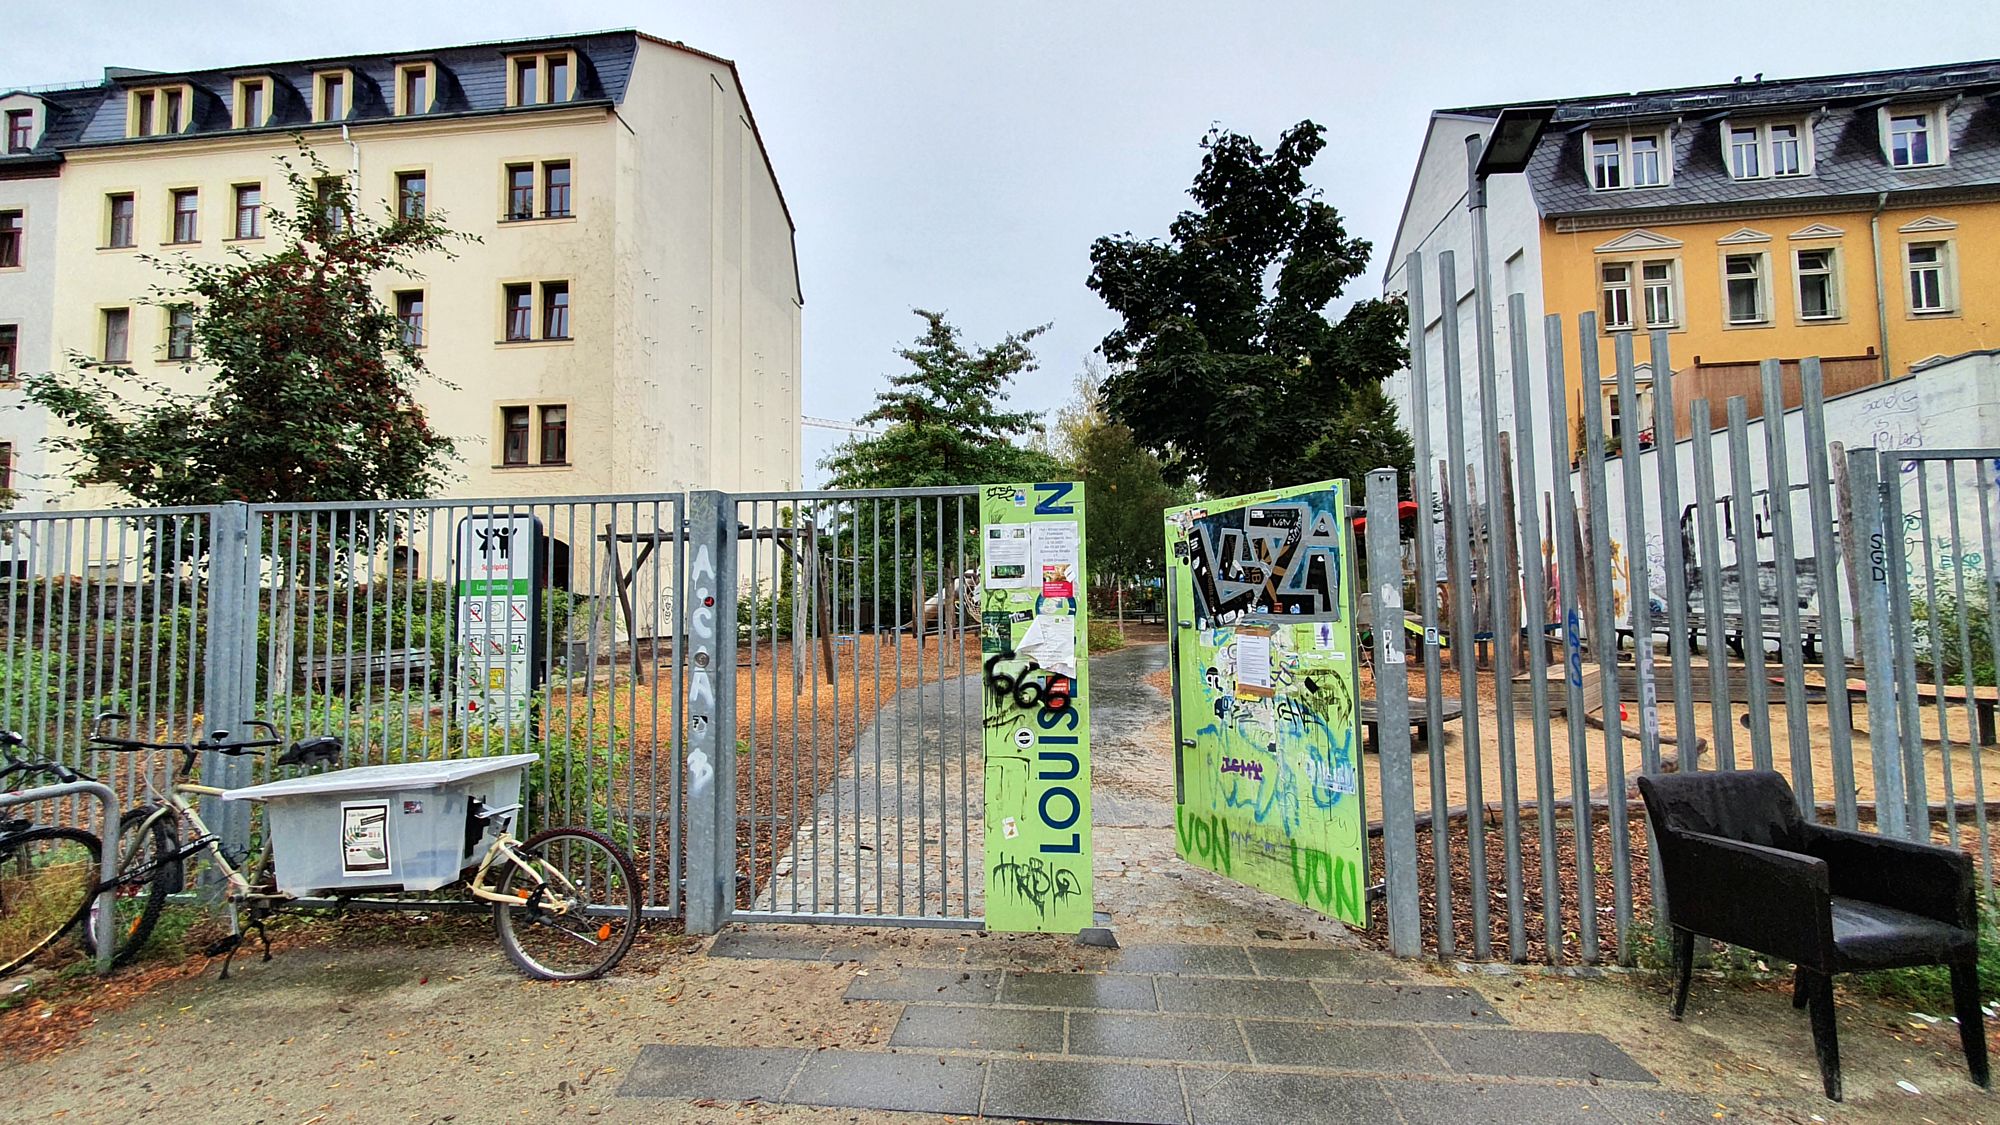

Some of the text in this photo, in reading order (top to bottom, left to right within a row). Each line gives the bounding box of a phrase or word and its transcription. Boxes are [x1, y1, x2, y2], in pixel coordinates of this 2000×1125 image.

[984, 650, 1071, 712] 666
[1177, 805, 1231, 877] VON
[1291, 838, 1360, 923] VON
